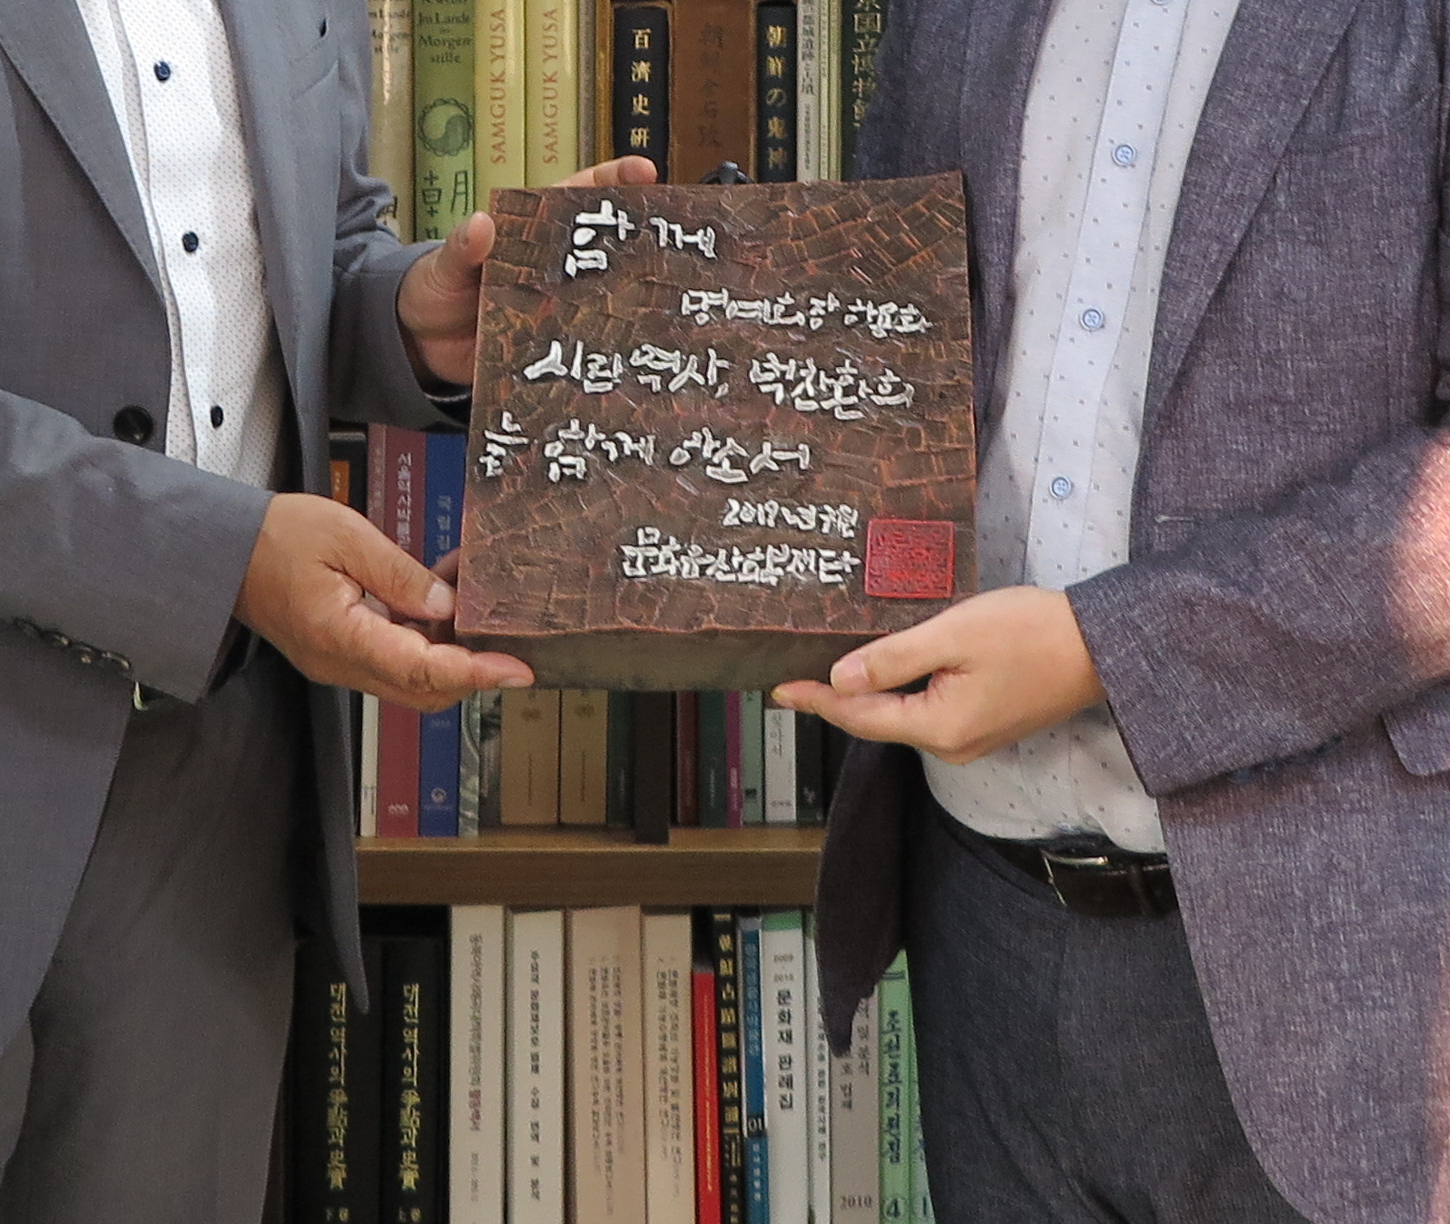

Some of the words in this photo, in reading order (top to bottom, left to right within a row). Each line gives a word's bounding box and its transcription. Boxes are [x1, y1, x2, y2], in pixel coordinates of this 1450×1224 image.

[490, 8, 507, 63] YUSA
[542, 8, 559, 63] YUSA
[490, 71, 507, 165] SAMGUK
[542, 71, 559, 165] SAMGUK
[776, 988, 793, 1045] 문화재
